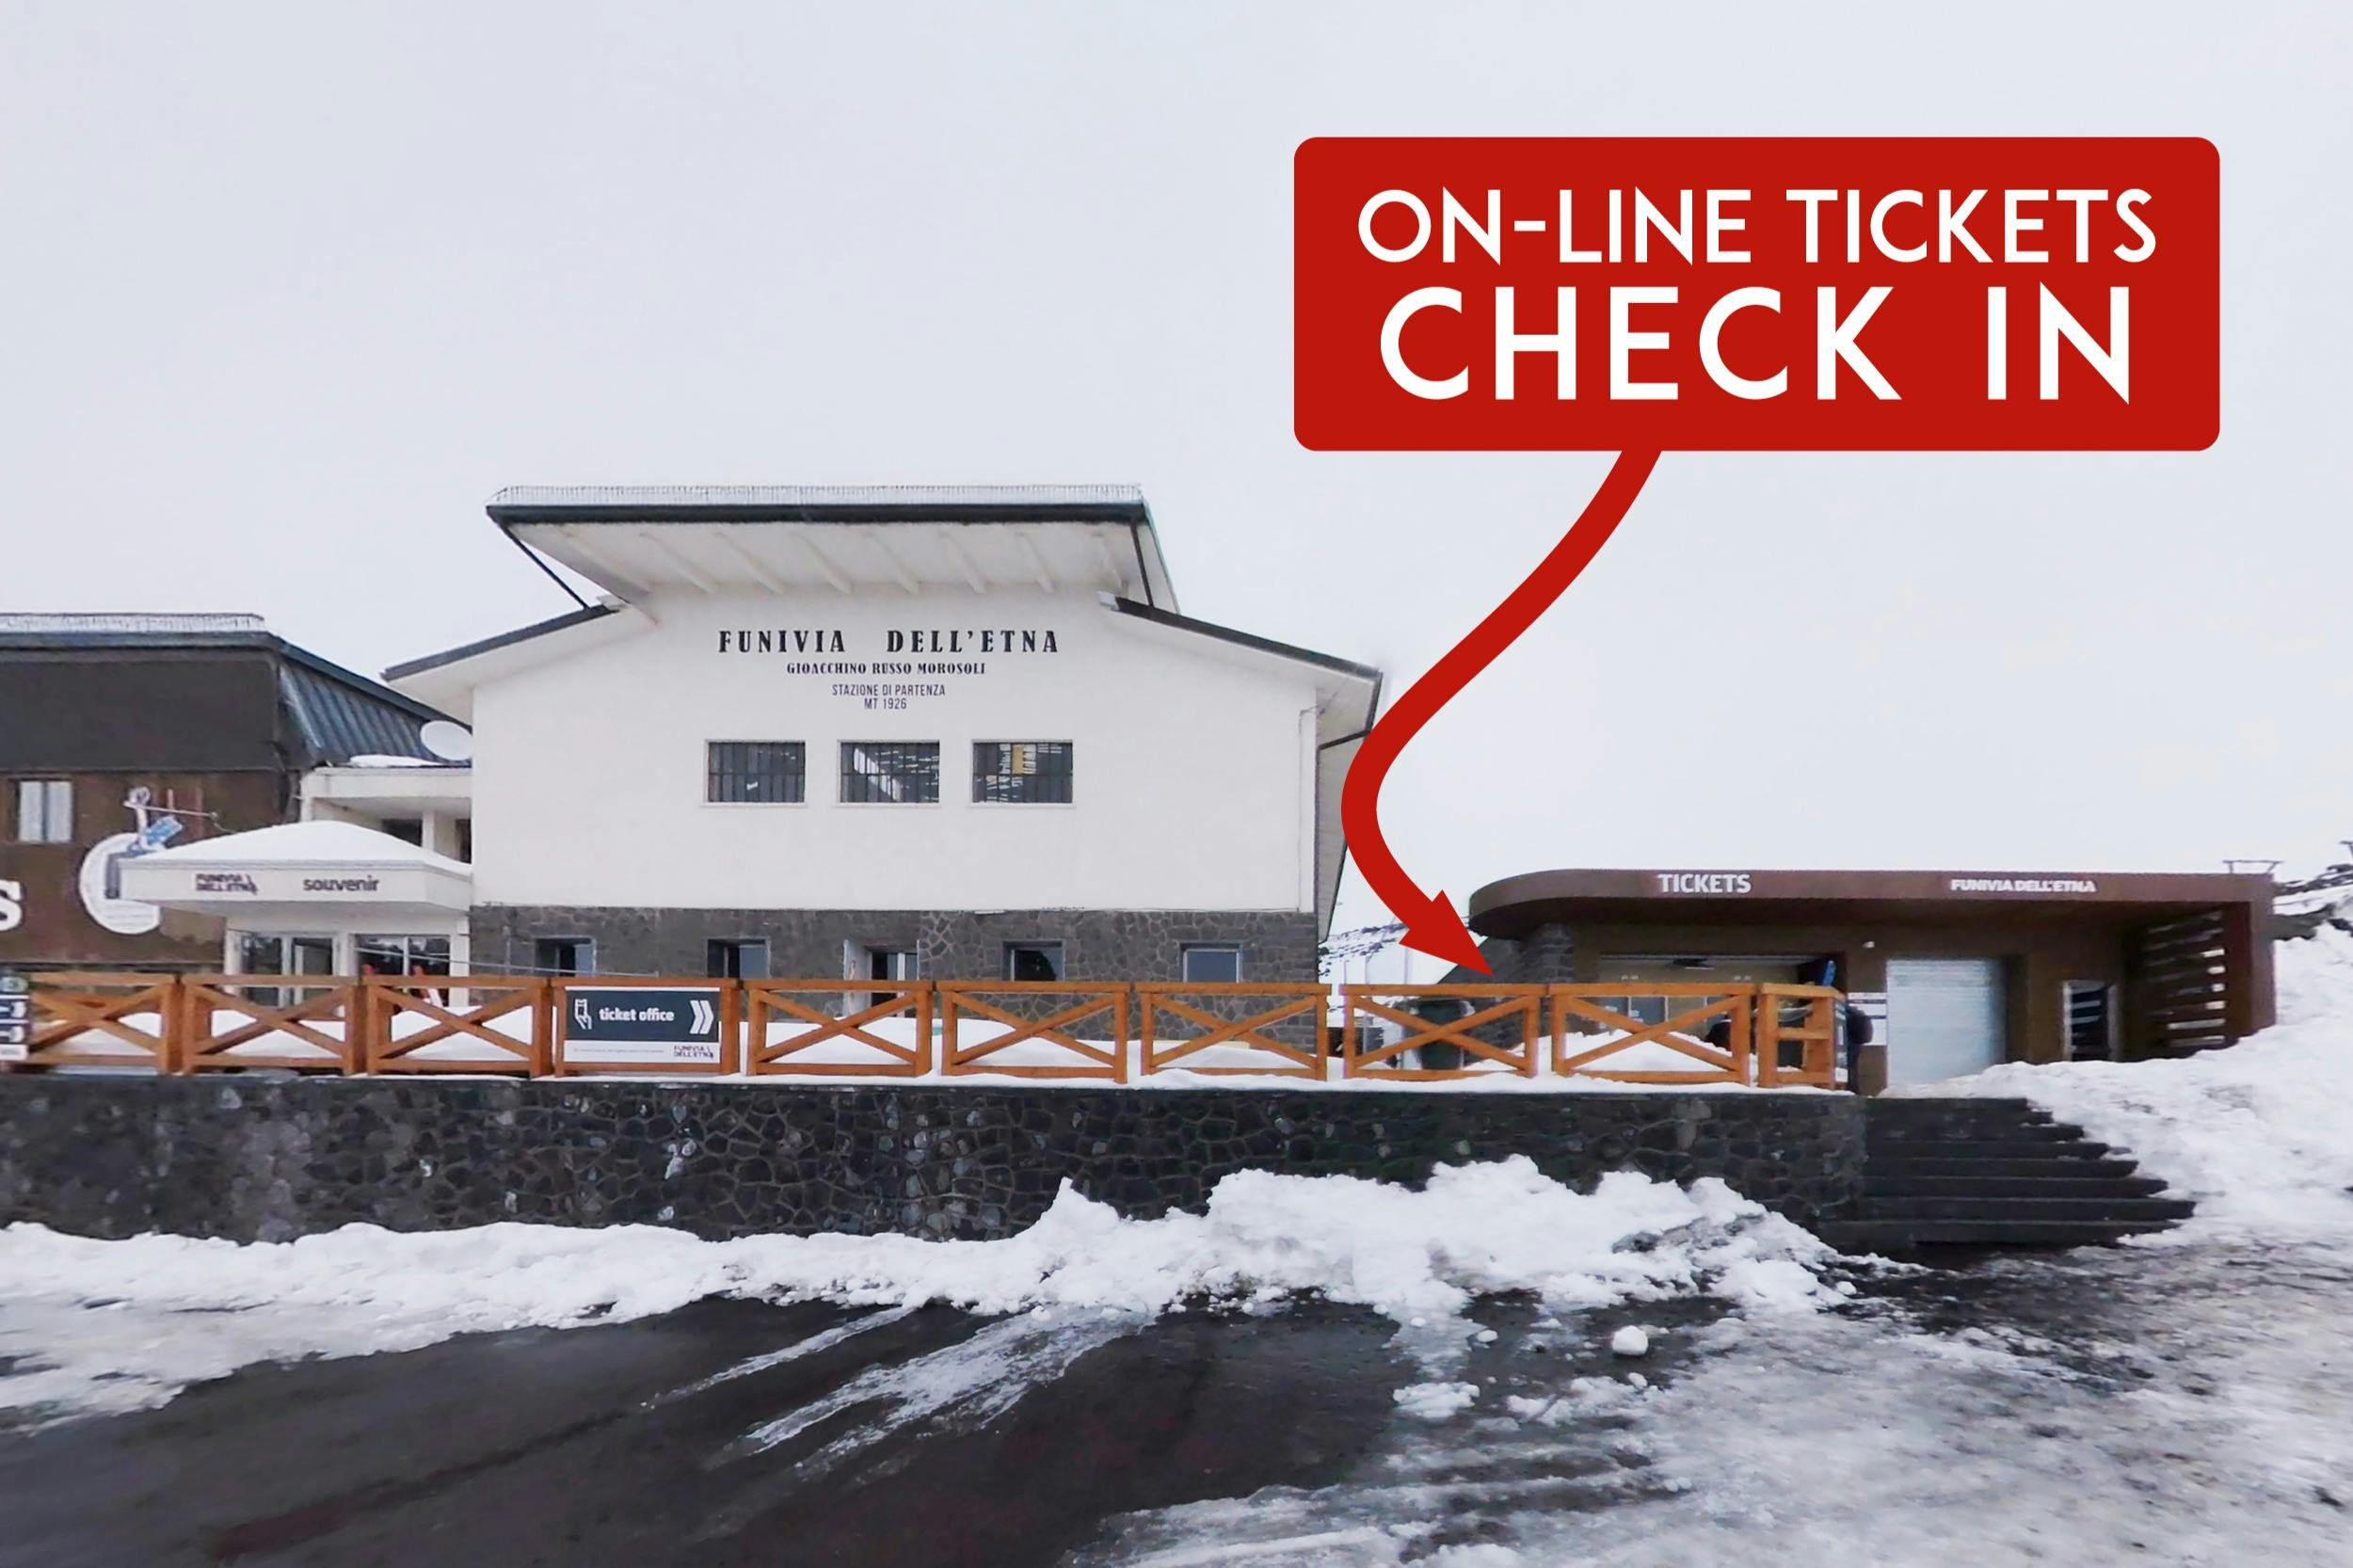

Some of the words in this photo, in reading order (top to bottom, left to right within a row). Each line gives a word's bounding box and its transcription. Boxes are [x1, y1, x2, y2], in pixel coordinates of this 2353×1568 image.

[718, 630, 845, 653] FUNIVIA
[886, 630, 1058, 653] DELL'ETNA
[787, 662, 867, 675] GIOACCHINO
[872, 662, 912, 675] RUSSO
[917, 662, 985, 675] MOROSOLI
[832, 683, 878, 696] STAZIONE
[882, 683, 892, 696] DI
[895, 683, 946, 696] PARTENZA
[864, 697, 878, 710] MT
[883, 697, 907, 710] 1926
[302, 874, 379, 892] souvenir
[1657, 873, 1752, 894] TICKETS
[1950, 878, 2012, 891] FUNIVIA
[599, 1007, 636, 1022] ticket
[639, 1007, 675, 1022] office
